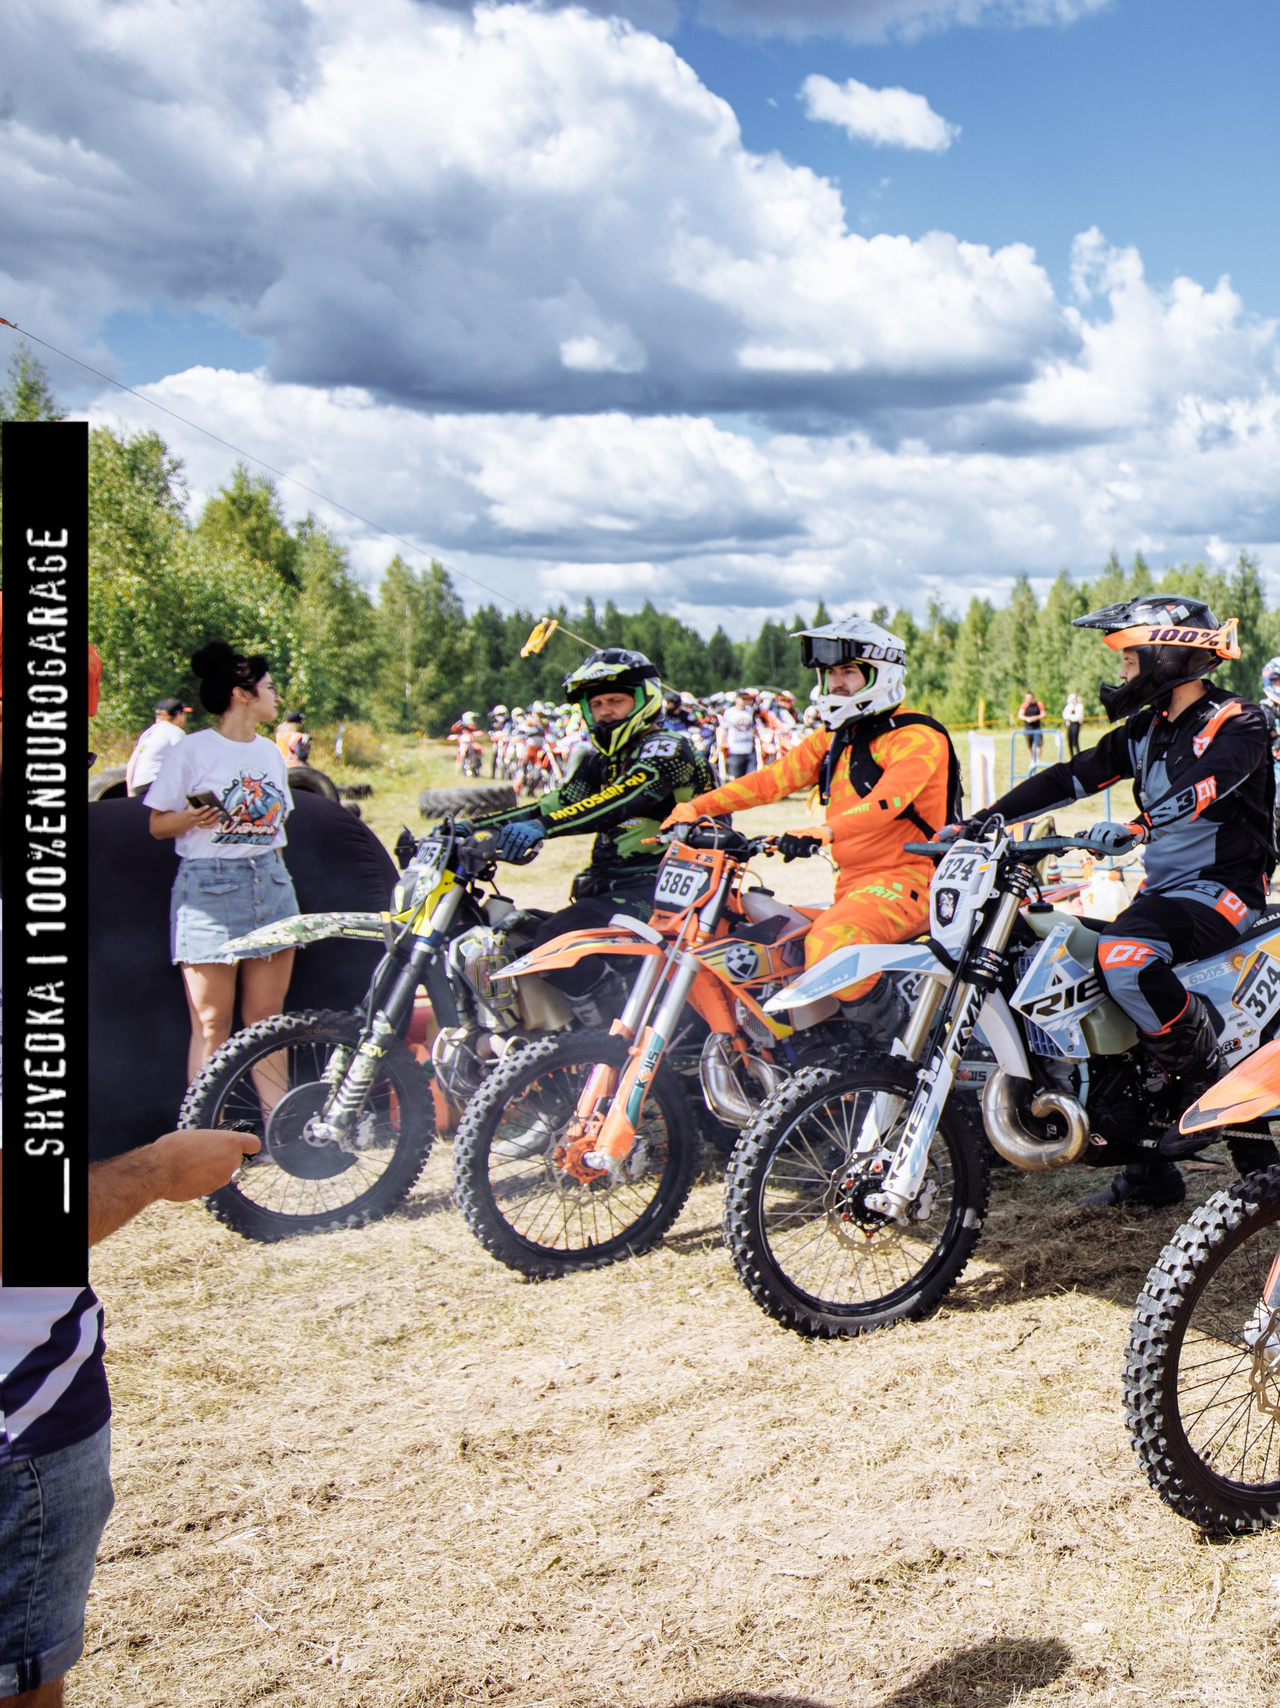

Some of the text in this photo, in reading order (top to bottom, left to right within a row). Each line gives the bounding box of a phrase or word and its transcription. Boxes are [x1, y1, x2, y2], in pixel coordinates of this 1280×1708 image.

[1148, 627, 1219, 648] 100%
[639, 739, 679, 759] 33
[937, 857, 978, 882] 324
[659, 871, 695, 897] 386
[1020, 977, 1102, 1020] RIE
